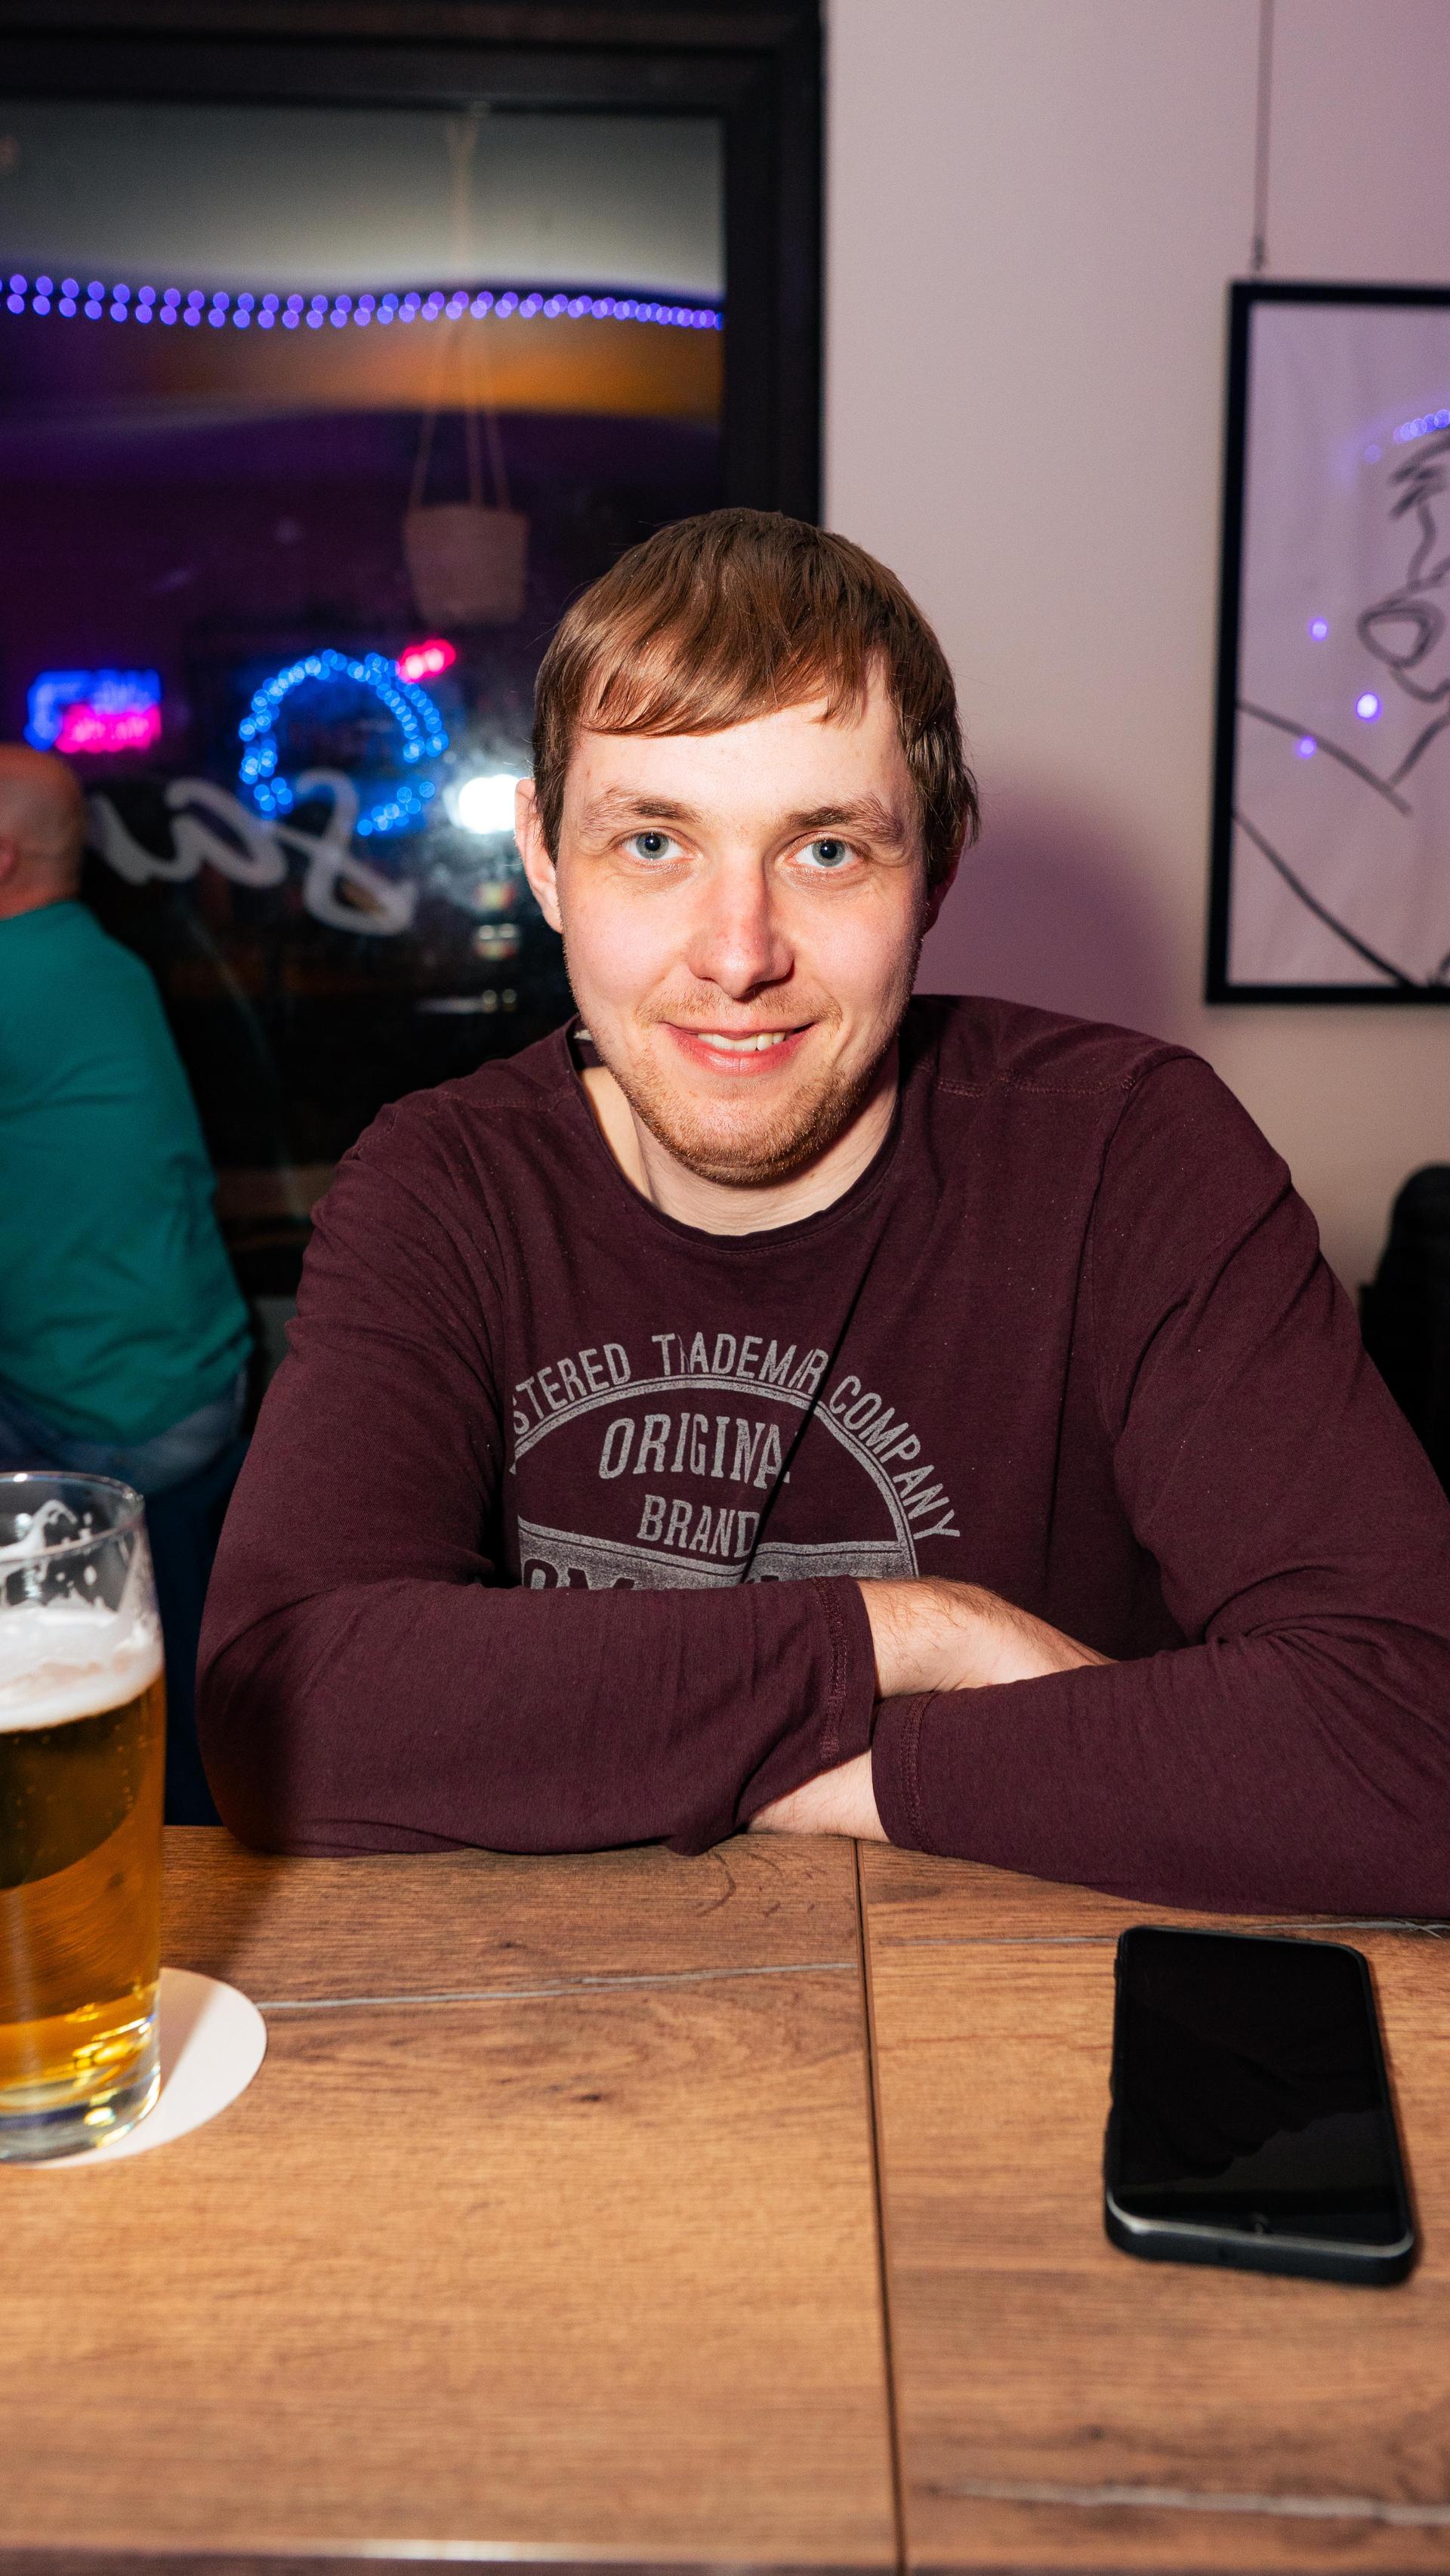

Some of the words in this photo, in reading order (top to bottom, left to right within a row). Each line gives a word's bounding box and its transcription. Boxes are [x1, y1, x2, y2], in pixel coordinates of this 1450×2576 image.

[599, 1411, 798, 1489] ORIGINA
[829, 1375, 961, 1540] COMPANY
[637, 1494, 760, 1557] BRAND
